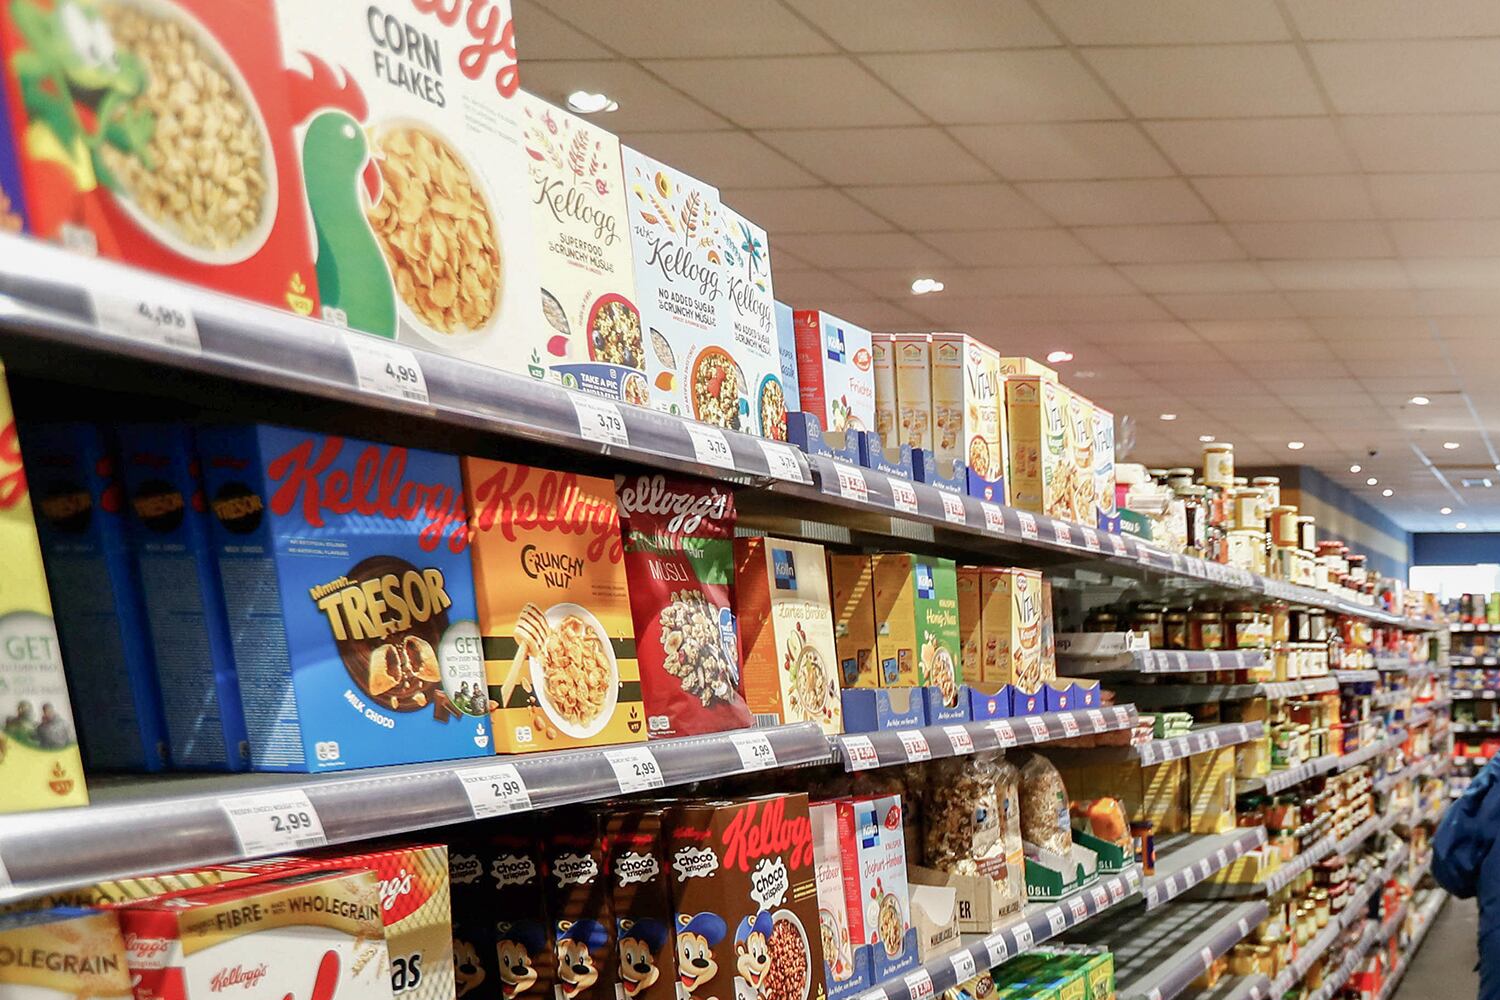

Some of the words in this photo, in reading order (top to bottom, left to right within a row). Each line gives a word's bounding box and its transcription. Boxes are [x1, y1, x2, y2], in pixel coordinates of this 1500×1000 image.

[367, 5, 443, 77] CORN
[373, 48, 446, 108] FLAKES
[535, 176, 621, 246] Kellogg
[560, 233, 603, 257] SUPERFOOD
[646, 237, 723, 301] Kellogg
[658, 287, 669, 299] NO
[670, 292, 693, 308] ADDED
[694, 298, 716, 315] SUGAR
[727, 276, 773, 333] Kellogg
[384, 361, 418, 384] 4,99
[580, 373, 599, 385] TAKE
[605, 380, 617, 390] PIC
[599, 414, 621, 430] 3,79
[707, 440, 727, 454] 3,79
[780, 456, 797, 469] 3,79
[519, 544, 584, 579] CRUNCHY
[650, 559, 688, 583] MÜSLI
[774, 560, 796, 579] Kölln
[543, 571, 571, 588] NUT
[319, 568, 451, 642] TRESOR
[5, 634, 54, 660] GET
[343, 688, 364, 712] MILK
[364, 706, 396, 730] CHOCO
[752, 742, 771, 757] 2,99
[632, 761, 656, 777] 2,99
[491, 781, 519, 798] 2,99
[271, 812, 311, 833] 2,99
[558, 860, 593, 873] choco
[620, 858, 654, 872] choco
[679, 853, 713, 867] choco
[684, 862, 712, 873] krispies
[756, 867, 784, 892] choco
[762, 884, 783, 901] krispies
[216, 904, 263, 931] FIBRE
[289, 895, 380, 922] WHOLEGRAIN
[210, 962, 268, 992] Kellogg's
